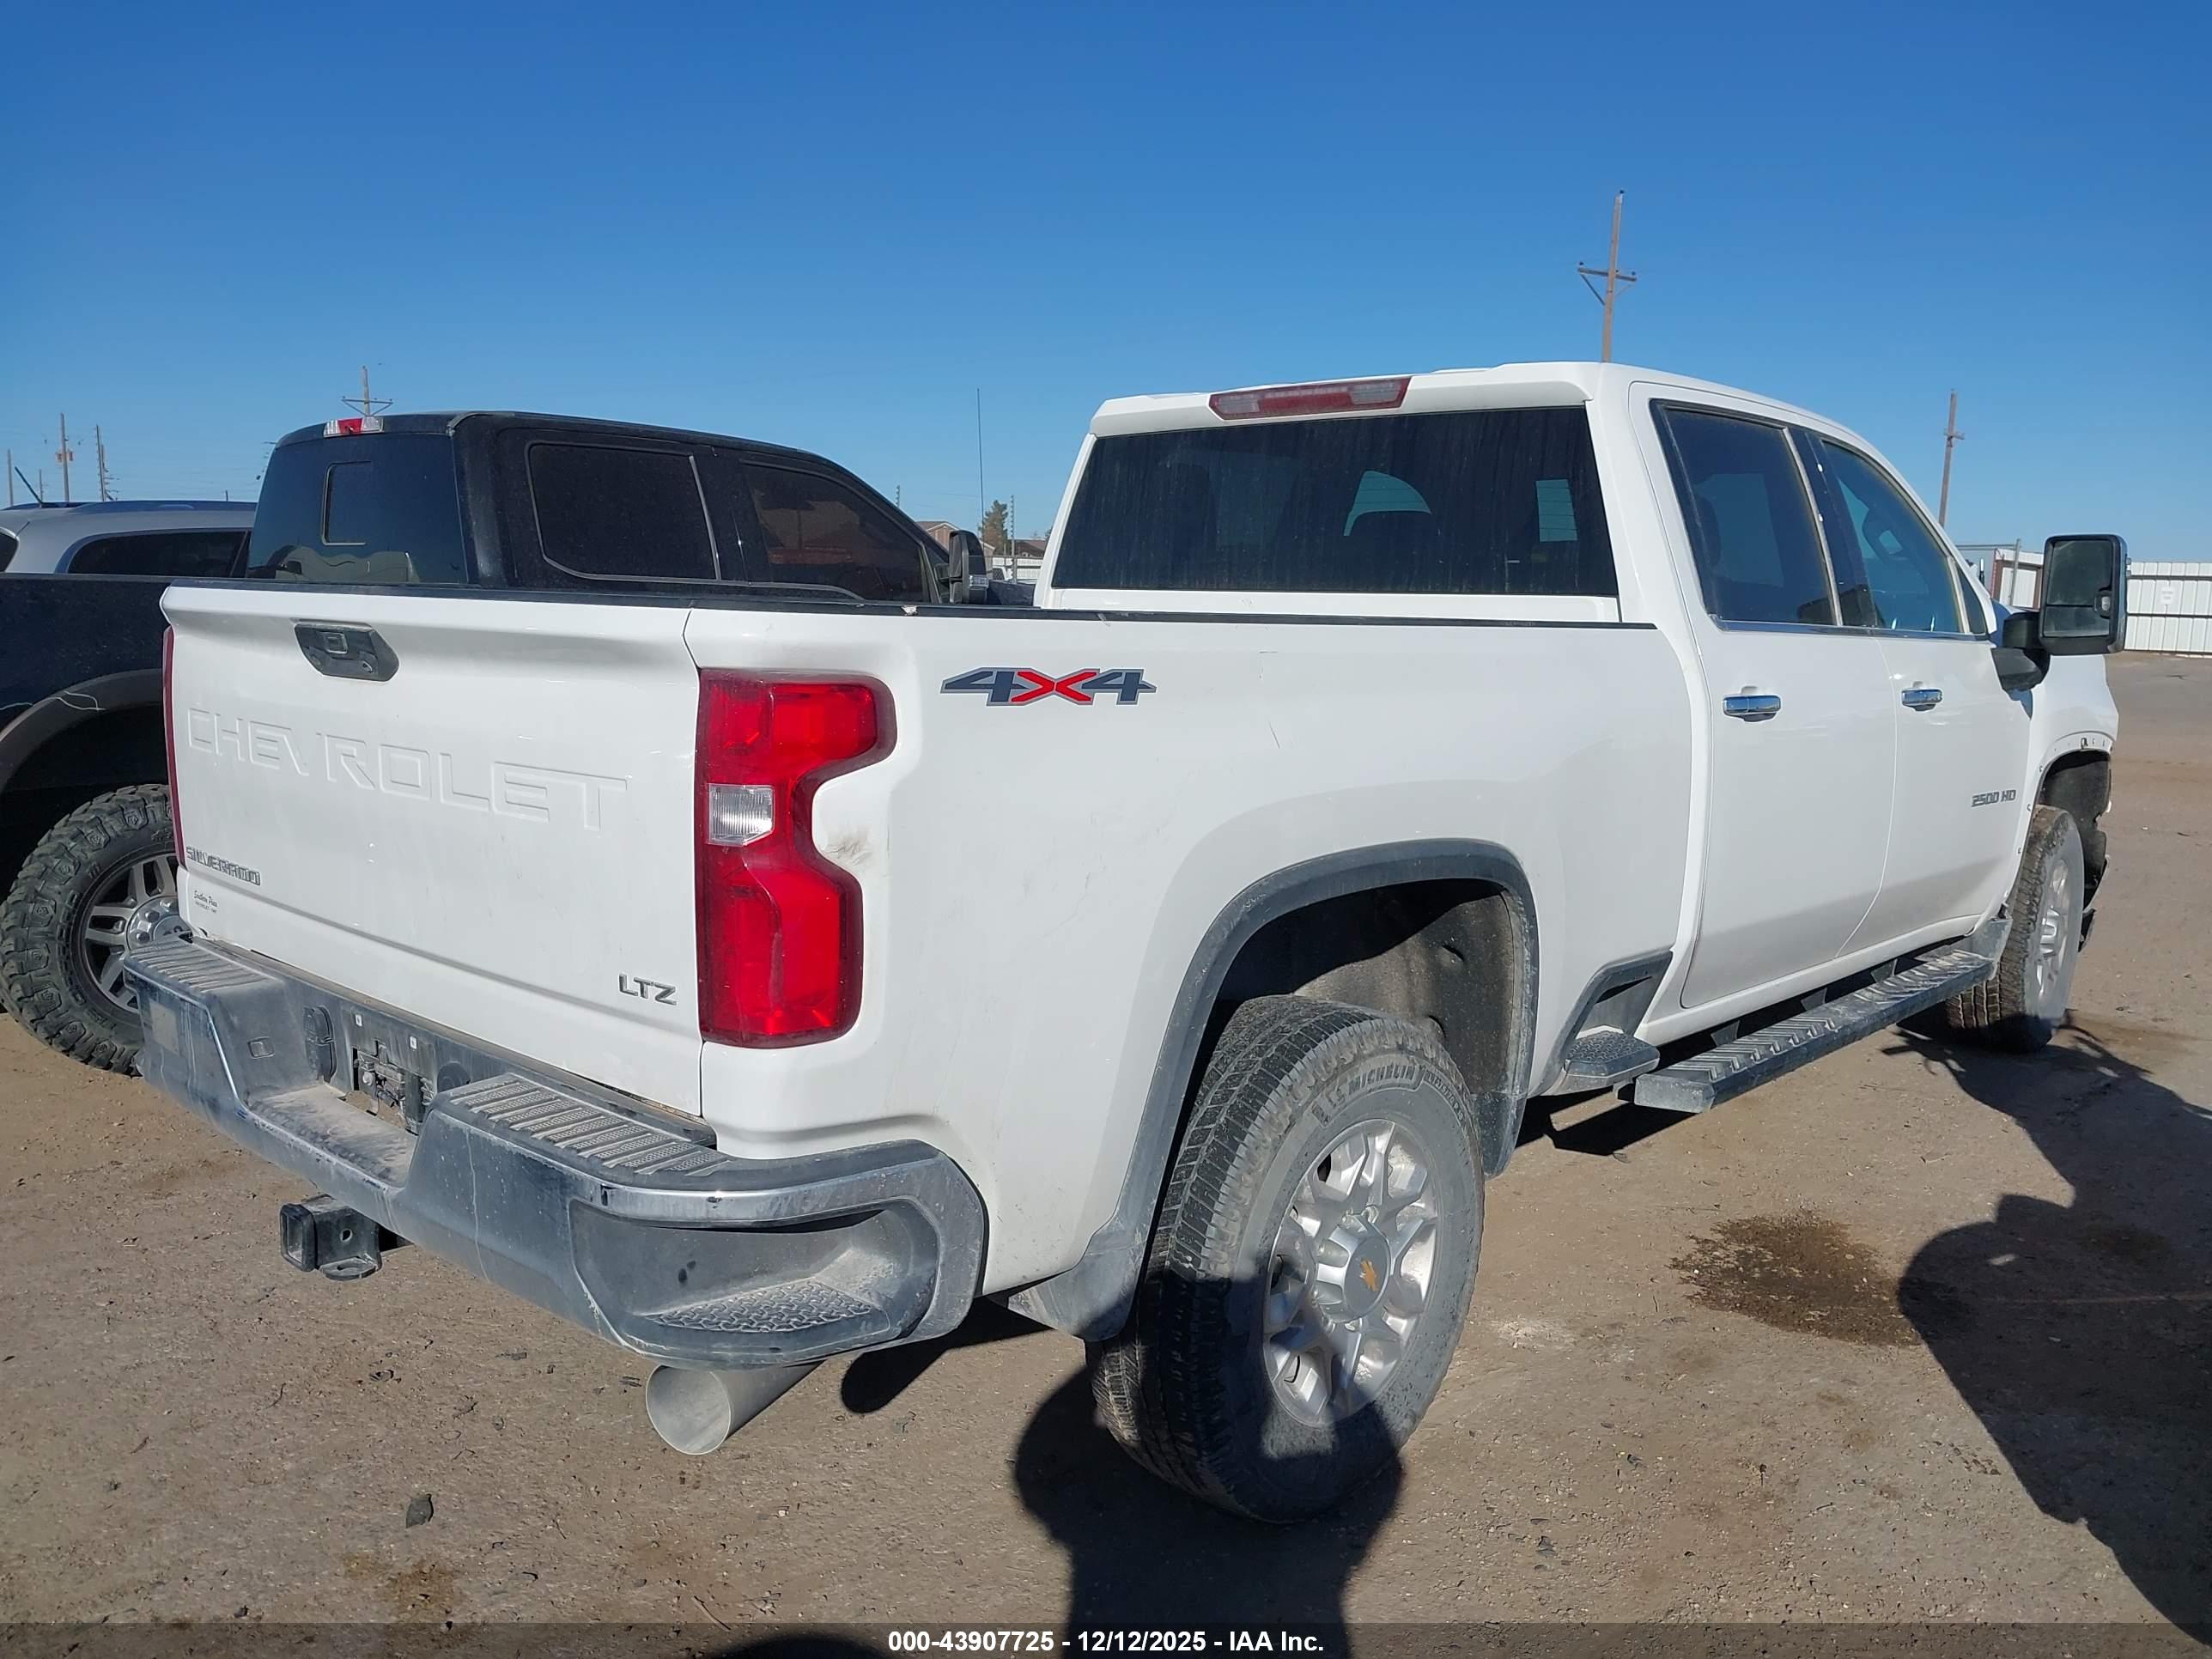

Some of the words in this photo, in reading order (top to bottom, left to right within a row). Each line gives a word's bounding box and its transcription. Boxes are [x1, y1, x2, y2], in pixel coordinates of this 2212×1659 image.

[187, 708, 628, 832] CHEVROLET
[1972, 791, 2000, 807] 2500
[2001, 789, 2016, 802] HD
[185, 846, 261, 886] SILVERADO
[618, 974, 677, 1006] LTZ
[1347, 1062, 1418, 1093] MICHELIN
